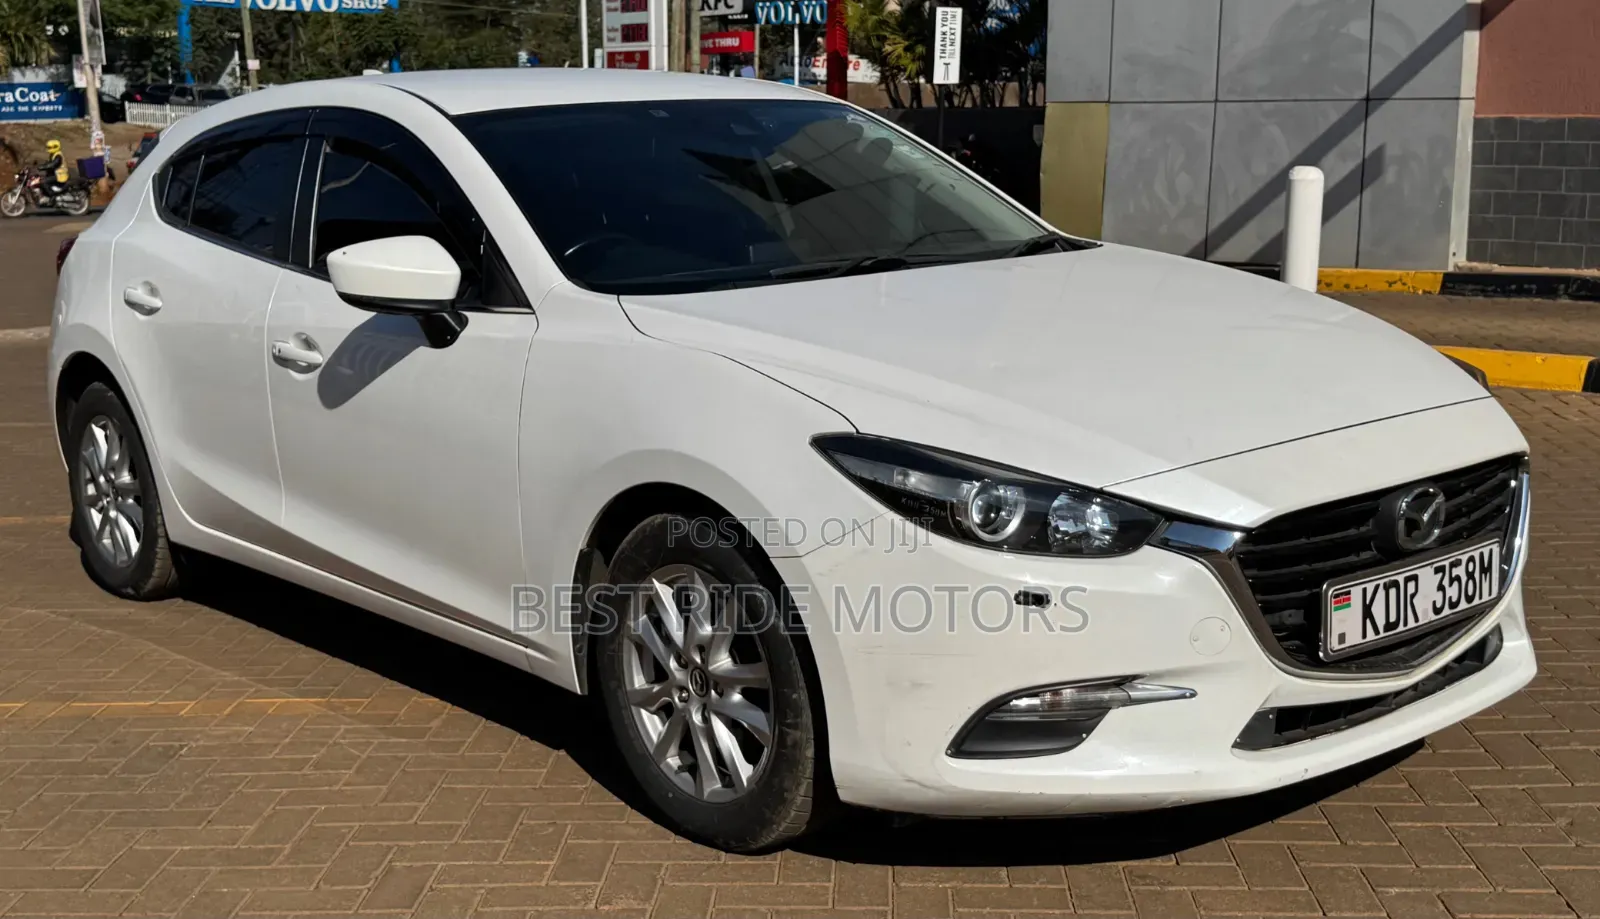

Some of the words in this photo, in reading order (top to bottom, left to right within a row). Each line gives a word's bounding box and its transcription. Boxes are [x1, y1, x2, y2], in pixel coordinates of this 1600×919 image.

[700, 0, 734, 11] KFC
[756, 1, 827, 25] VOLVO
[940, 10, 949, 28] YOU
[715, 37, 740, 48] THRU
[939, 30, 948, 60] THANK
[948, 27, 957, 47] NEXT
[948, 48, 956, 59] TILL
[1361, 573, 1420, 640] KDR
[1432, 547, 1494, 616] 358M
